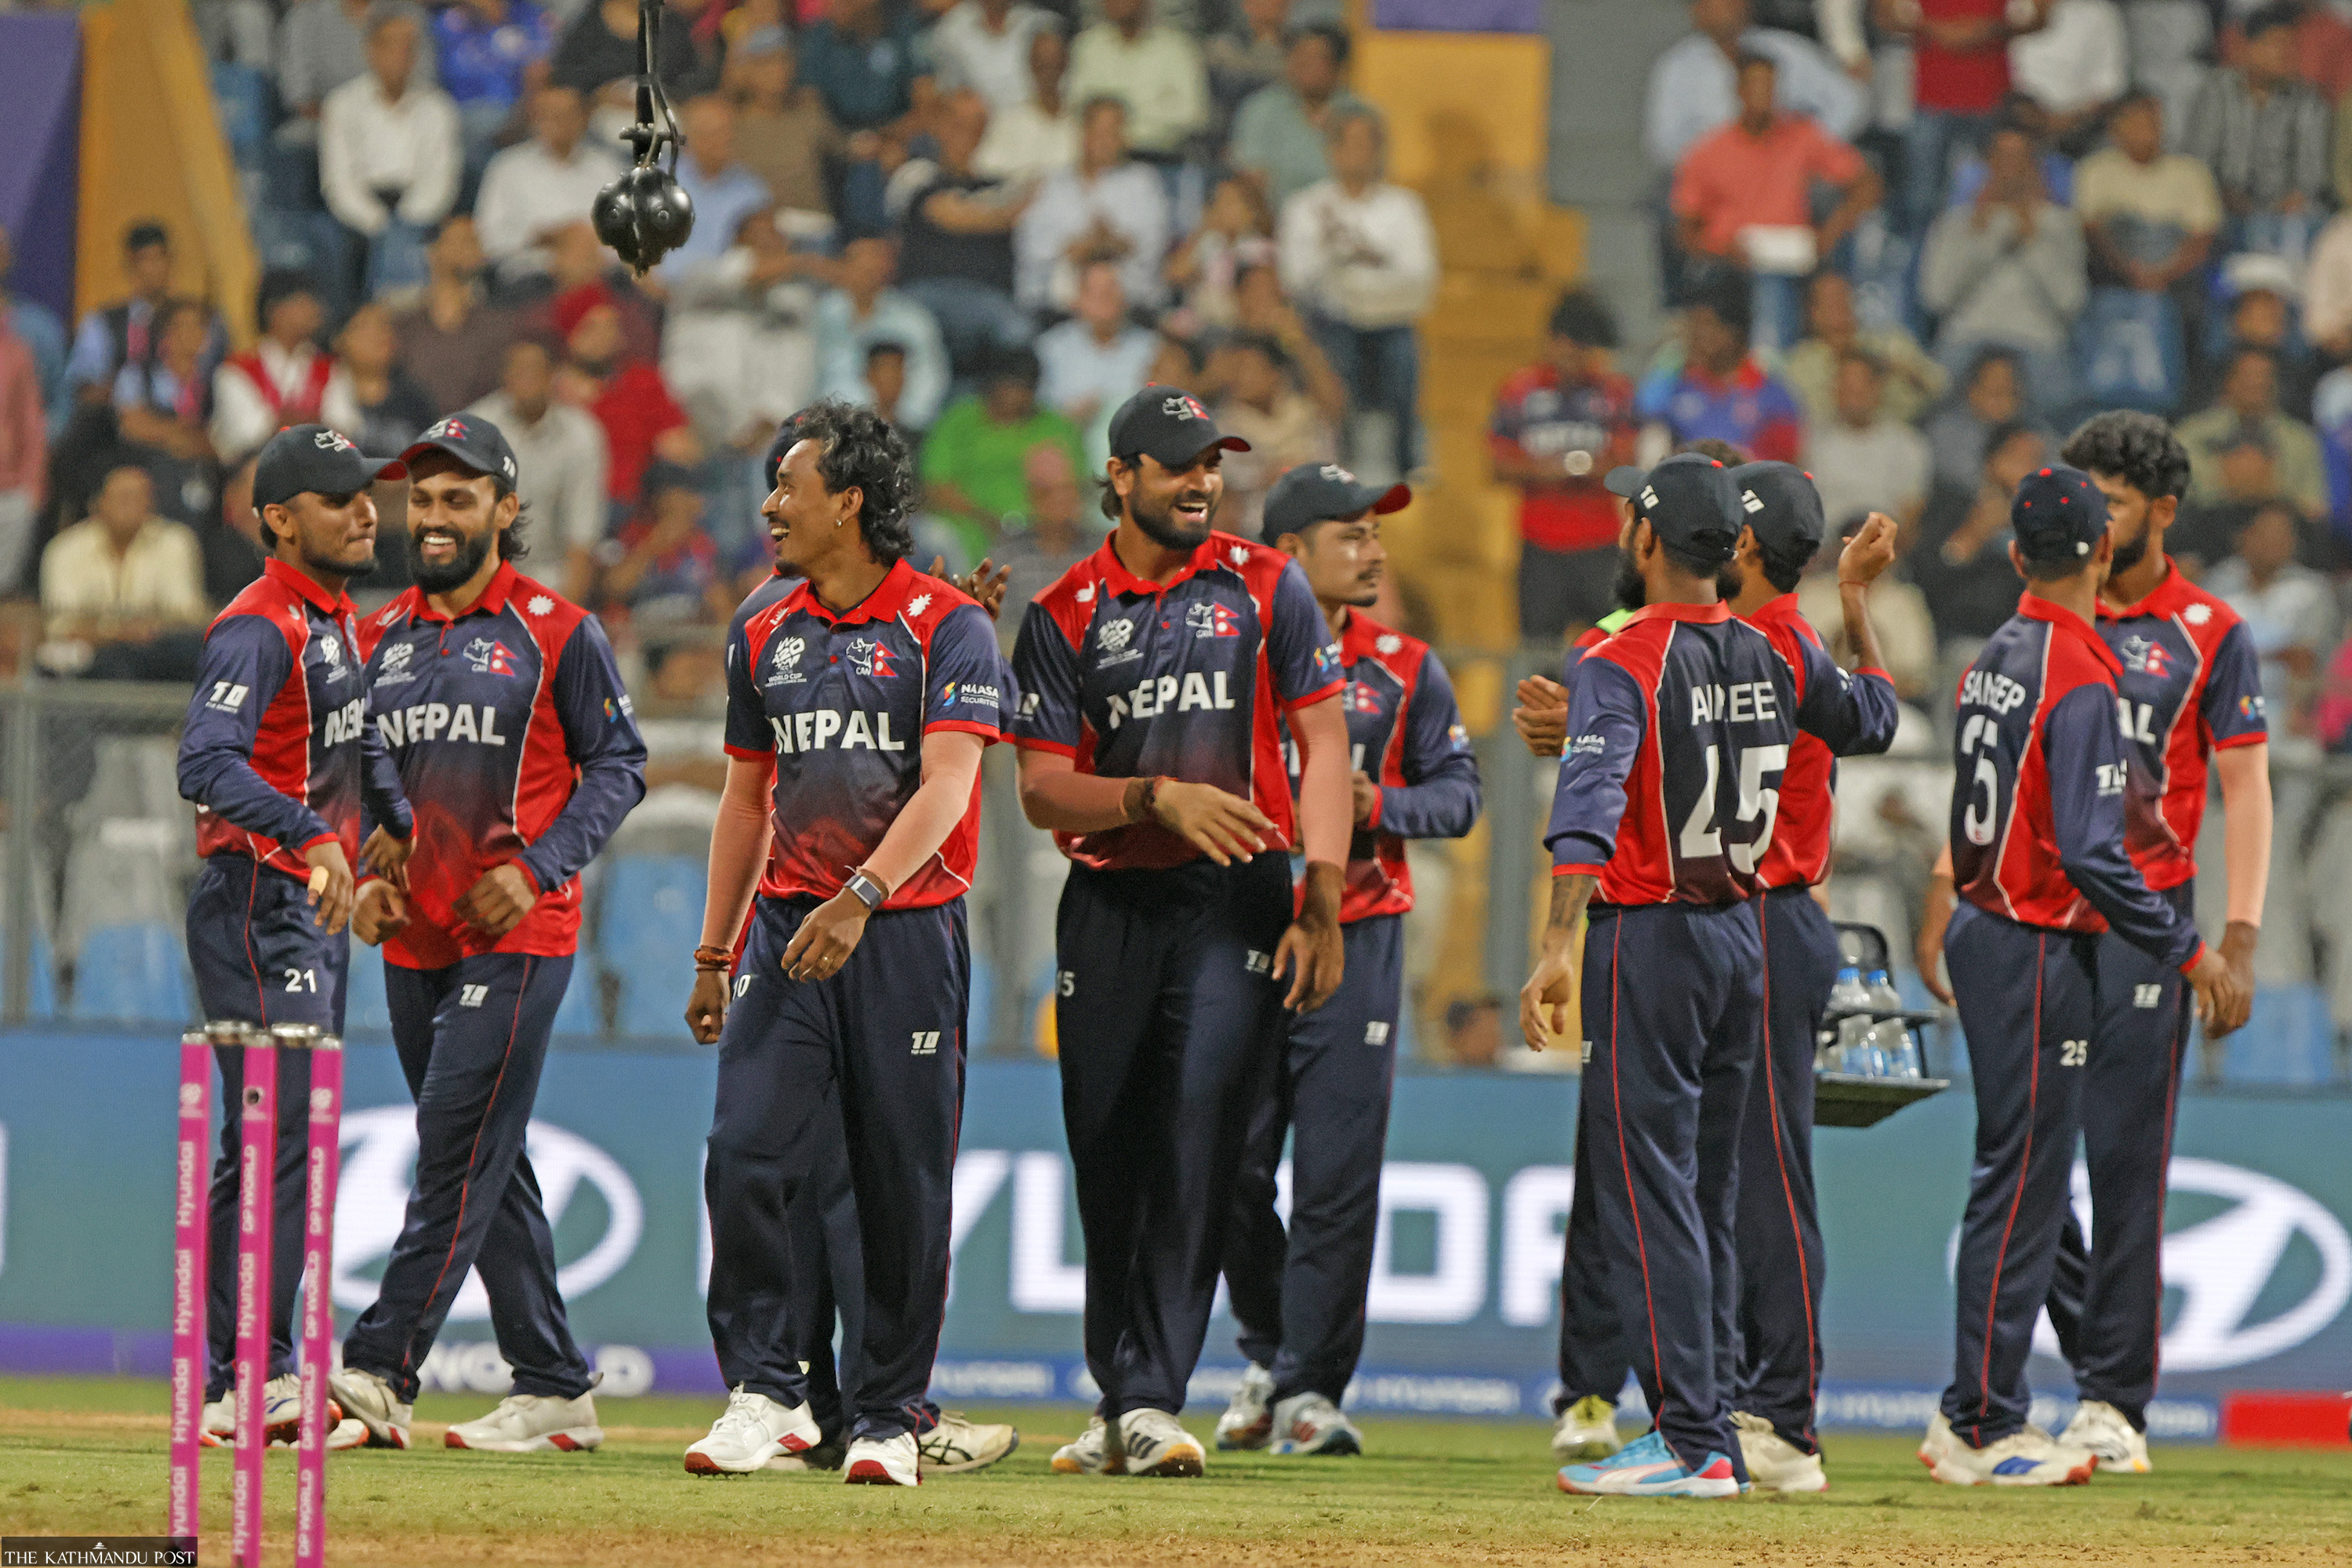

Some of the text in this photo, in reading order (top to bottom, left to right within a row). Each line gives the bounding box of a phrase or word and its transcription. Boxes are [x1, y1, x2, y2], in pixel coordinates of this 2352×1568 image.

[376, 702, 506, 750] NEPAL
[770, 709, 906, 754] NEPAL
[960, 684, 1000, 699] NAASA
[284, 967, 317, 994] 21
[2060, 1039, 2089, 1066] 25
[176, 1141, 195, 1228] Hyundai
[241, 1144, 257, 1234] DP WORLD
[309, 1145, 325, 1236] DP WORLD
[174, 1249, 193, 1334] Hyundai
[238, 1252, 256, 1339] Hyundai
[304, 1250, 321, 1339] DP WORLD
[171, 1357, 191, 1443] Hyundai
[234, 1360, 252, 1450] DP WORLD
[300, 1362, 317, 1450] DP WORLD
[169, 1465, 190, 1541] yundai
[231, 1469, 250, 1555] Hyundai
[297, 1468, 314, 1558] DP WORLD
